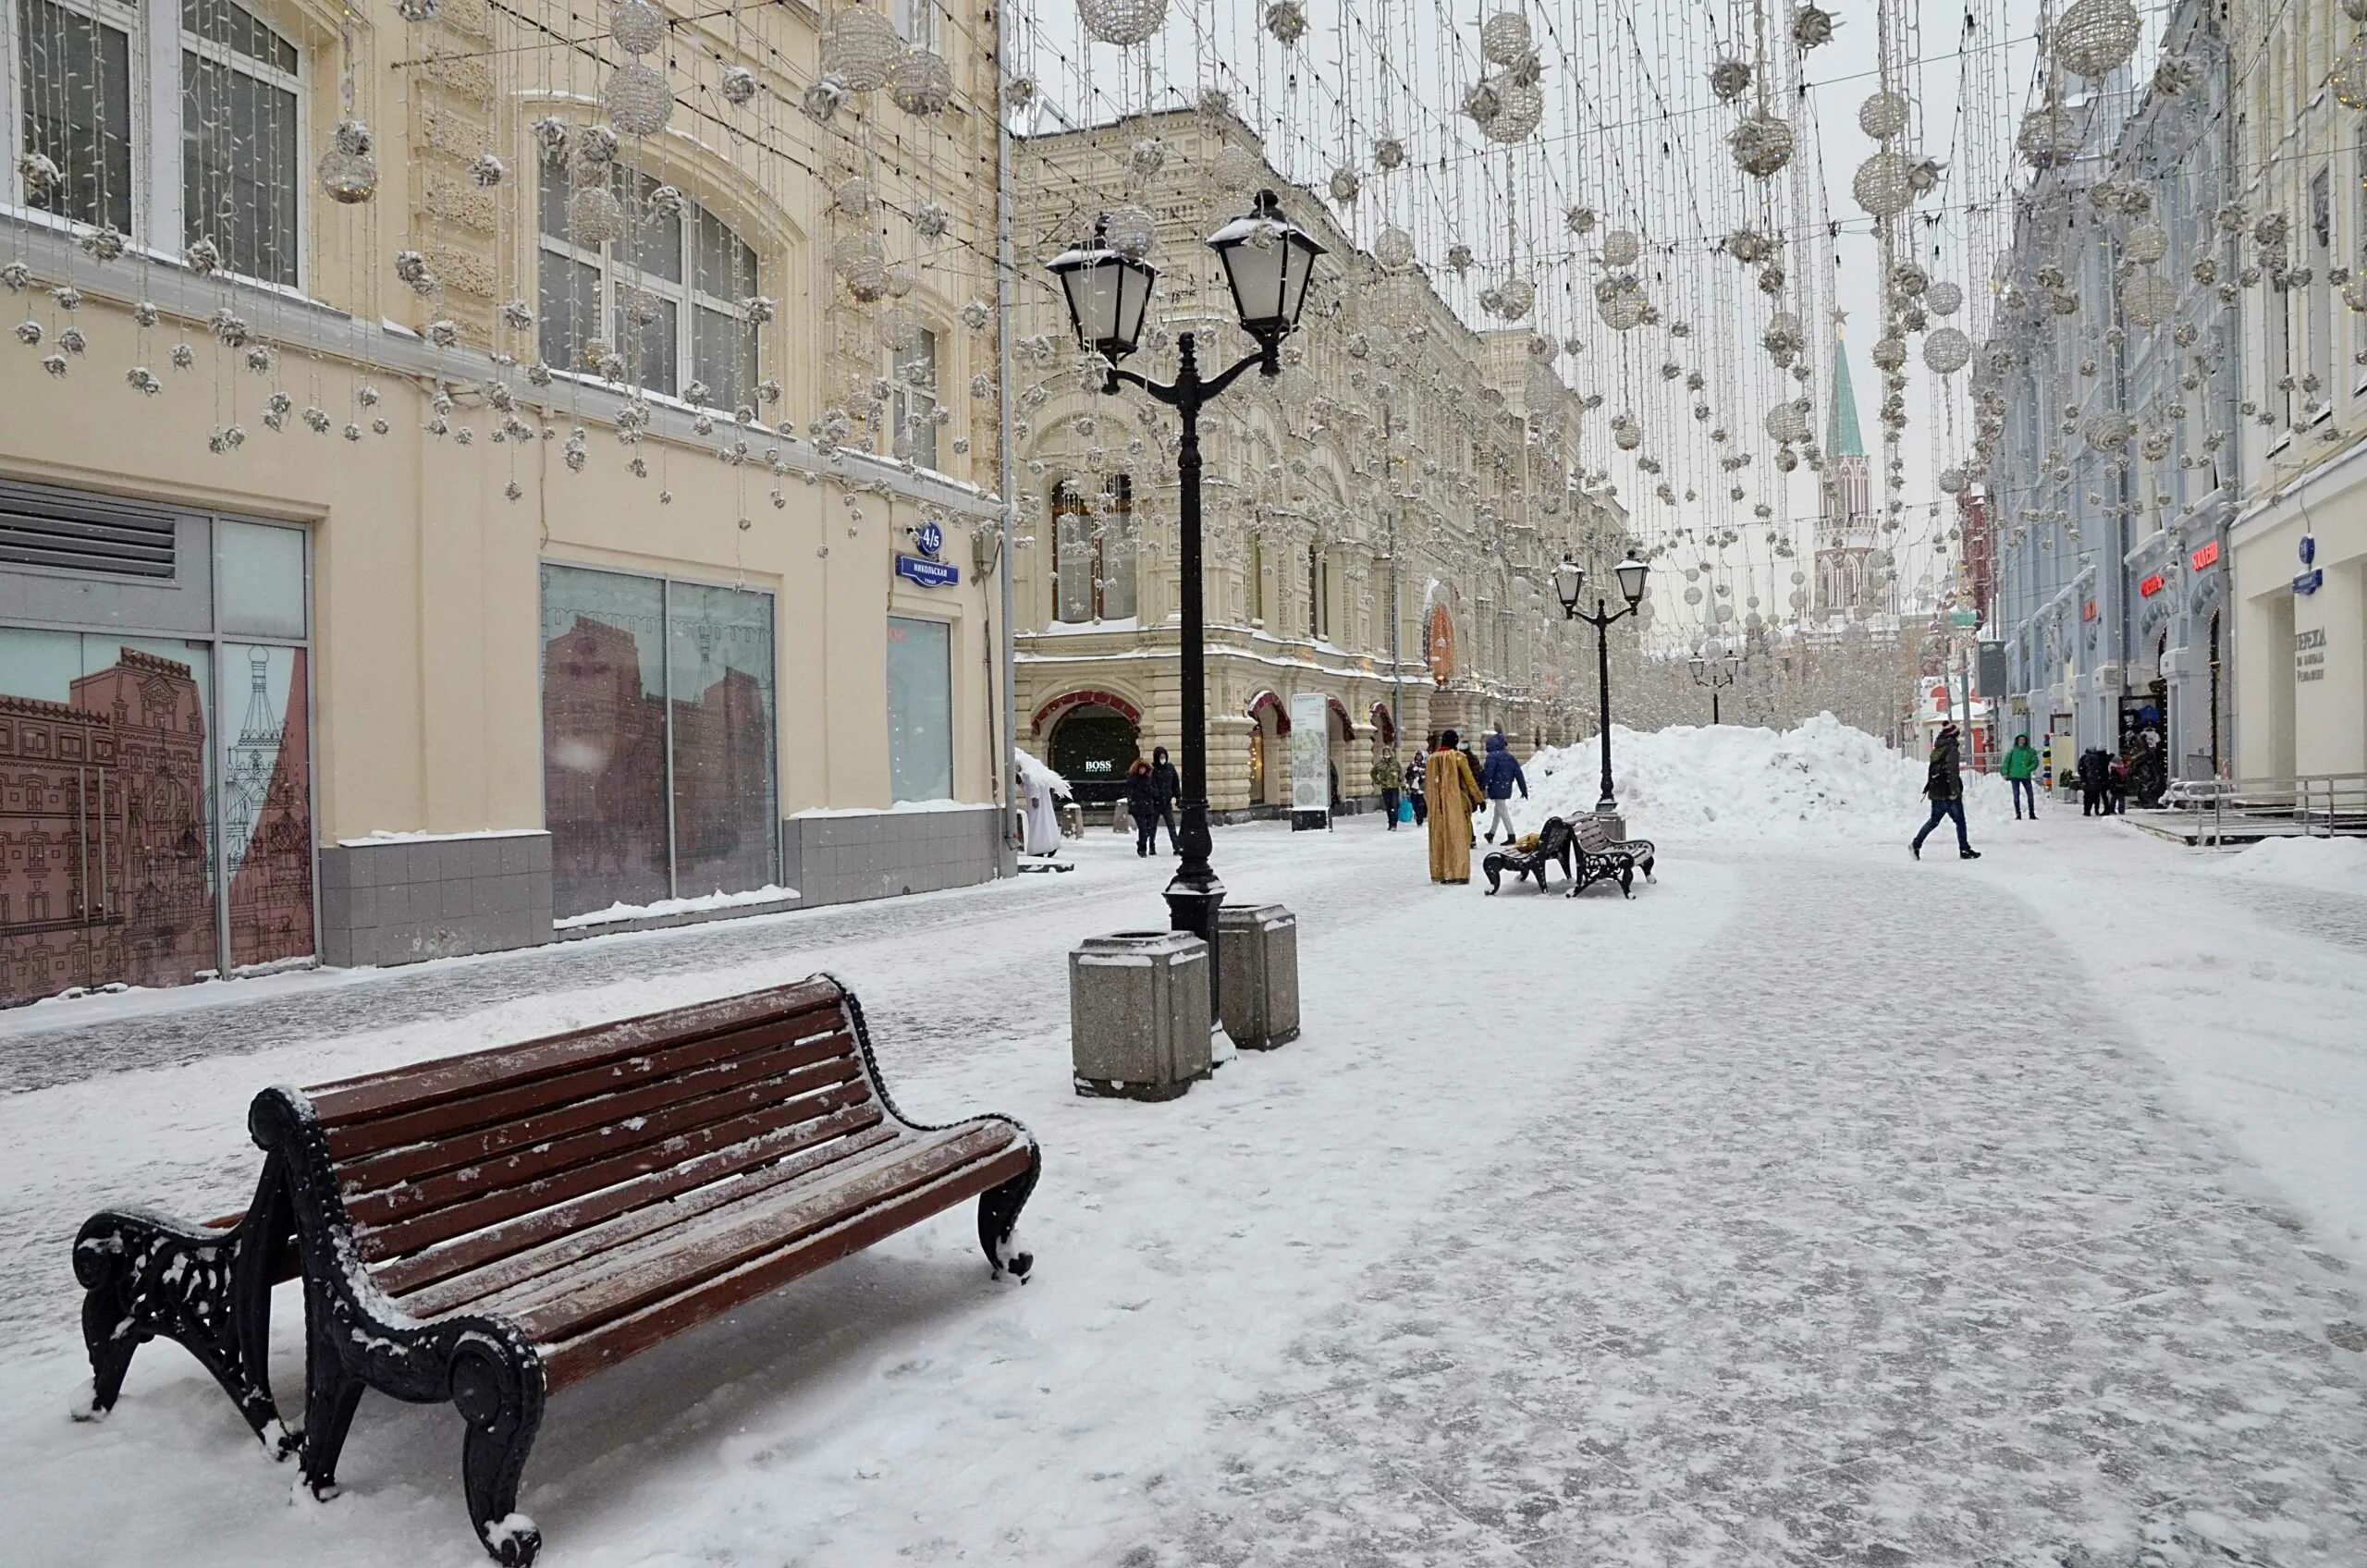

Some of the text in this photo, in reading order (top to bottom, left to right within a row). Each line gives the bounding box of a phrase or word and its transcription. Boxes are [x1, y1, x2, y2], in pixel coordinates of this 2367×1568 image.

[923, 529, 939, 547] 4/5
[914, 563, 948, 577] НИКОЛЬСКАЯ
[1085, 761, 1111, 769] BOSS
